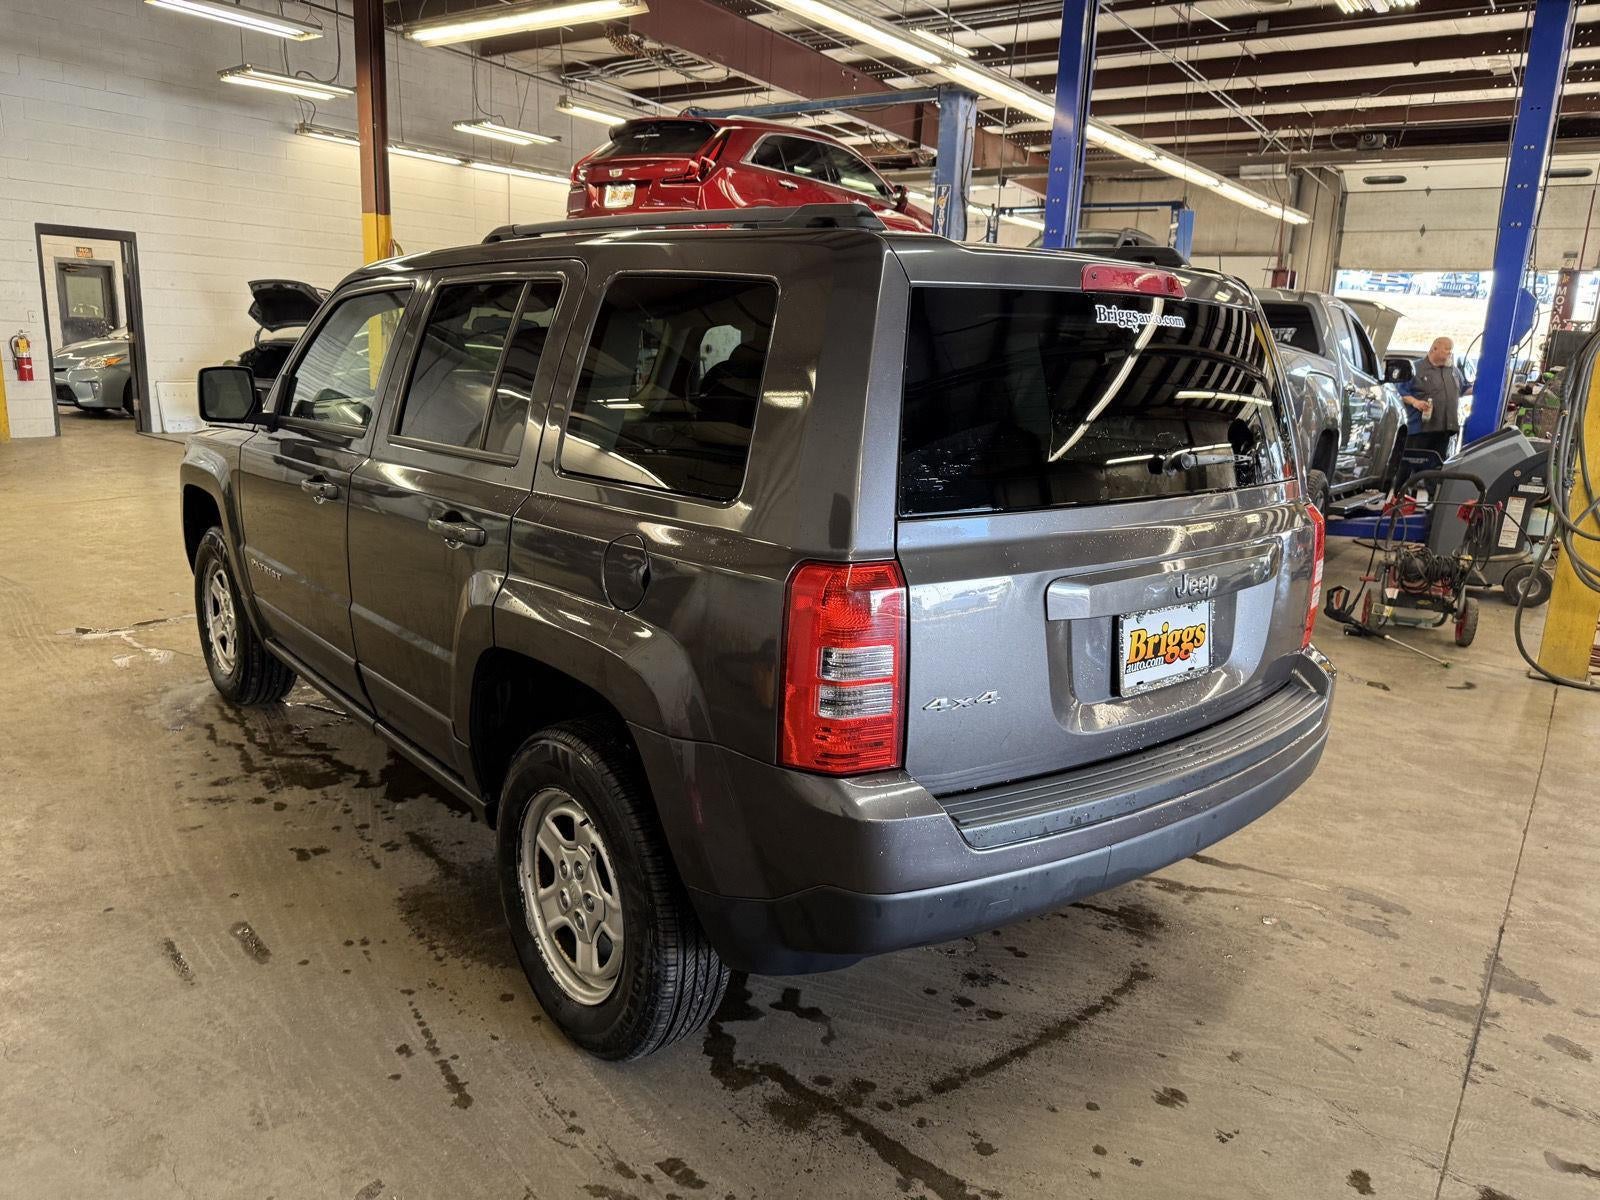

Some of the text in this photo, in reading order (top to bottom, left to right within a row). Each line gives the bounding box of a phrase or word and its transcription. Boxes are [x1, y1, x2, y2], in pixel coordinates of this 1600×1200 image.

[1095, 304, 1186, 329] Briggsauo.com
[1174, 573, 1218, 599] Jeep
[1126, 621, 1206, 664] Briggs
[1125, 657, 1164, 674] auto.com
